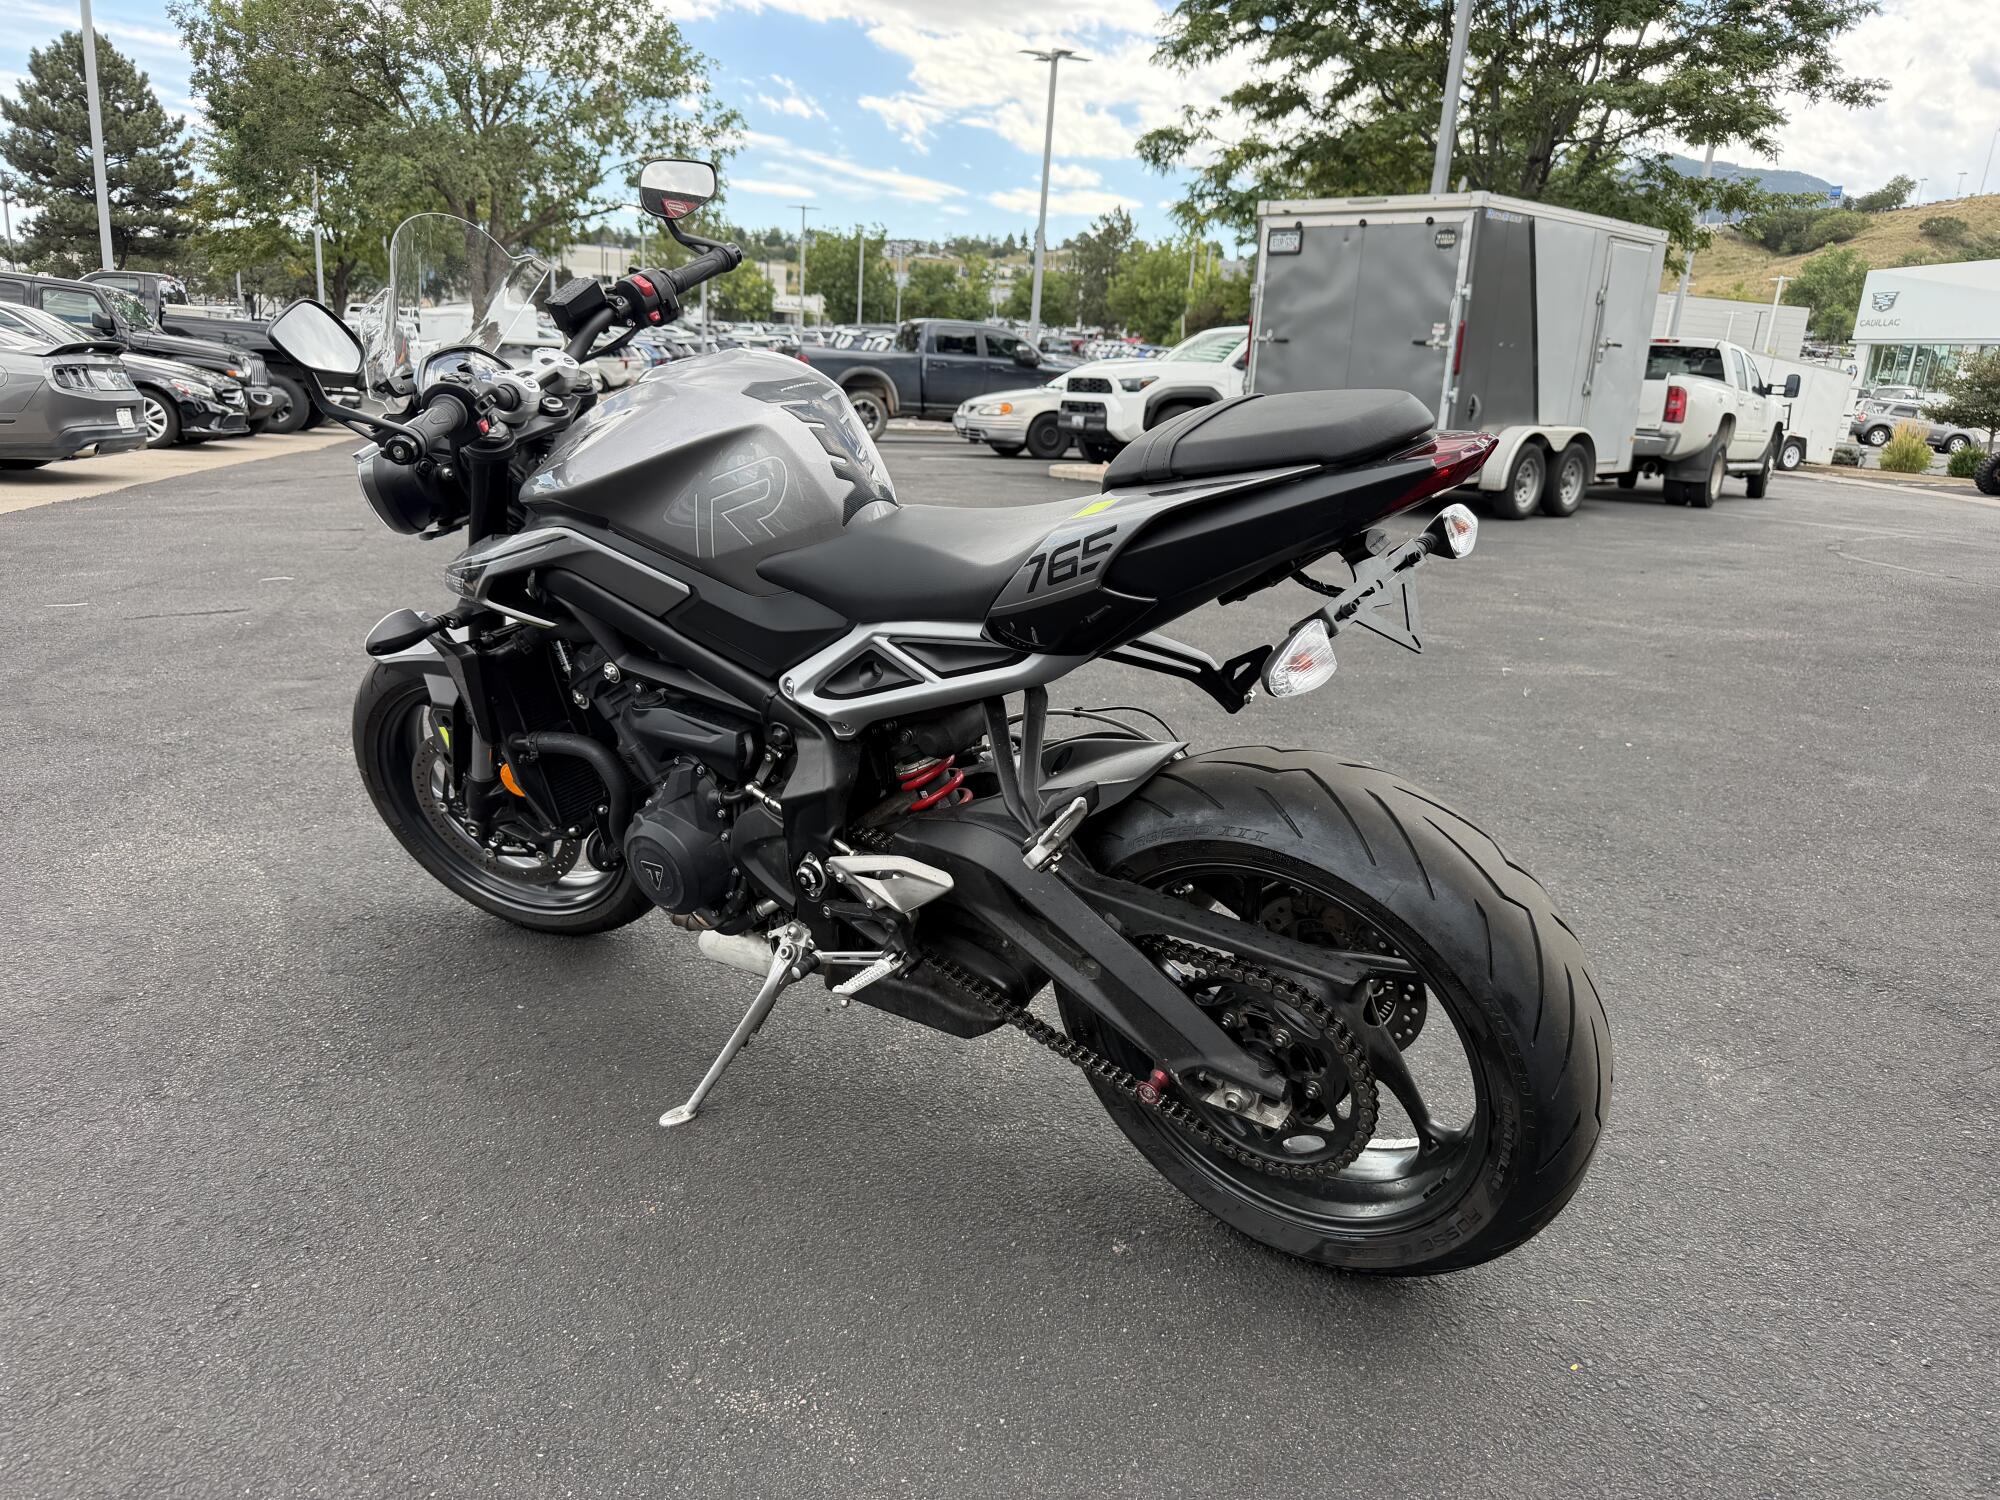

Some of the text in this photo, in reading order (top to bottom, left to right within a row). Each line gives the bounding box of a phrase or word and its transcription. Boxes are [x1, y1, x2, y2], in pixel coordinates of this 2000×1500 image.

[1859, 318, 1901, 327] CADILLAC
[1023, 524, 1118, 594] 765
[446, 573, 466, 588] STREET
